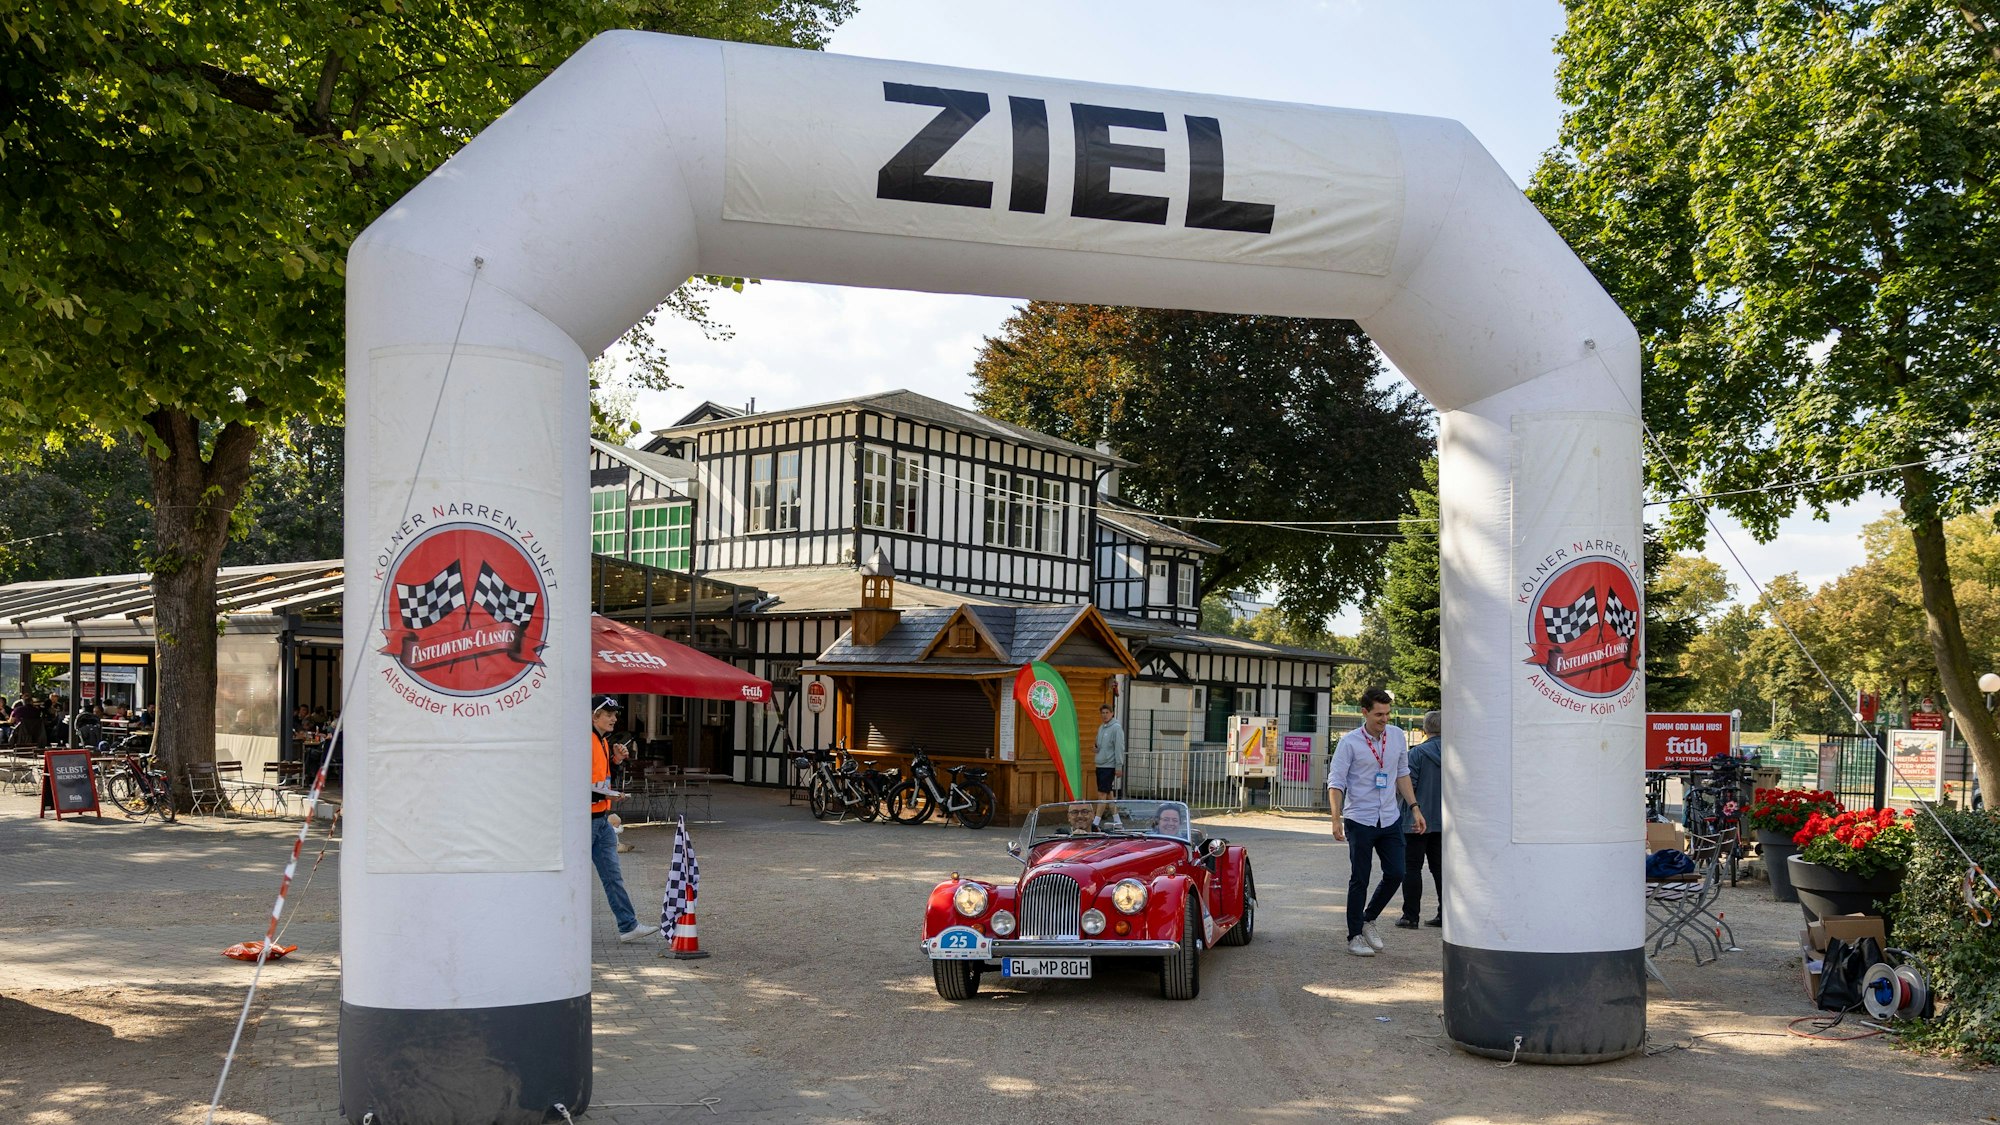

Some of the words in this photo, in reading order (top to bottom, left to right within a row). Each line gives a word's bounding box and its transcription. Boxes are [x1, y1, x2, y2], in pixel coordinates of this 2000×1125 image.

[877, 81, 1275, 234] ZIEL
[374, 513, 426, 581] KÖLNER
[432, 503, 558, 590] NARREN-ZUNFT
[1517, 548, 1568, 604] KÖLNER
[597, 650, 668, 667] früh
[381, 667, 447, 715] Altstädter
[453, 702, 490, 718] Köln
[496, 685, 532, 712] 1922
[741, 685, 763, 698] früh
[1527, 674, 1586, 713] Altstädter
[1590, 703, 1616, 715] Köln
[1617, 687, 1636, 710] 1922
[1652, 723, 1674, 731] KOMM
[1675, 723, 1689, 731] GOD
[1690, 723, 1705, 731] NAH
[1706, 723, 1723, 731] HUS!
[1666, 736, 1708, 756] früh
[56, 765, 86, 774] SELBST-
[949, 935, 968, 948] 25
[1011, 960, 1030, 975] GL
[1039, 960, 1058, 975] MP
[1060, 960, 1089, 976] 80H
